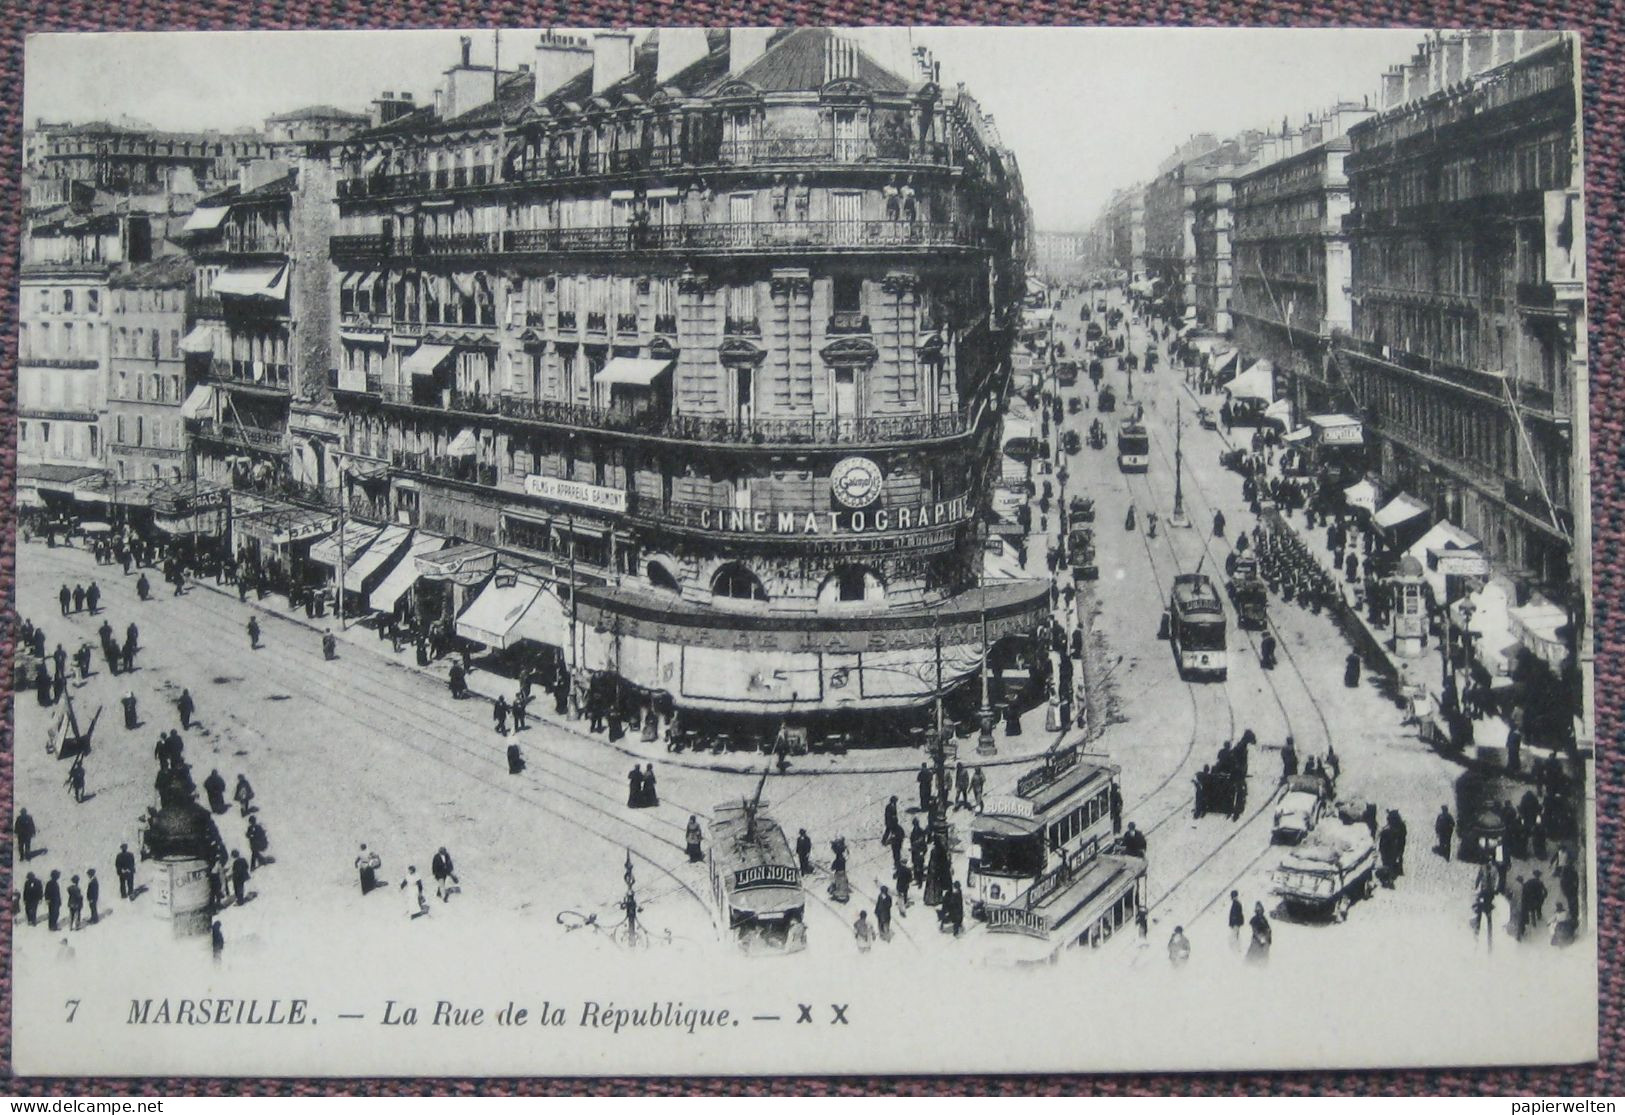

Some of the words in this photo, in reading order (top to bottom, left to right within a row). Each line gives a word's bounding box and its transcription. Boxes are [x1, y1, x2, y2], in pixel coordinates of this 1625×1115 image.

[289, 522, 325, 538] BAR
[738, 866, 765, 884] LION
[990, 909, 1016, 927] LION
[66, 1000, 80, 1022] 7
[126, 999, 318, 1025] MARSEILLE.
[382, 1002, 417, 1026] La
[433, 1002, 484, 1026] Rue
[499, 1002, 528, 1026] de
[541, 1002, 565, 1026] la
[580, 1002, 739, 1034] République.
